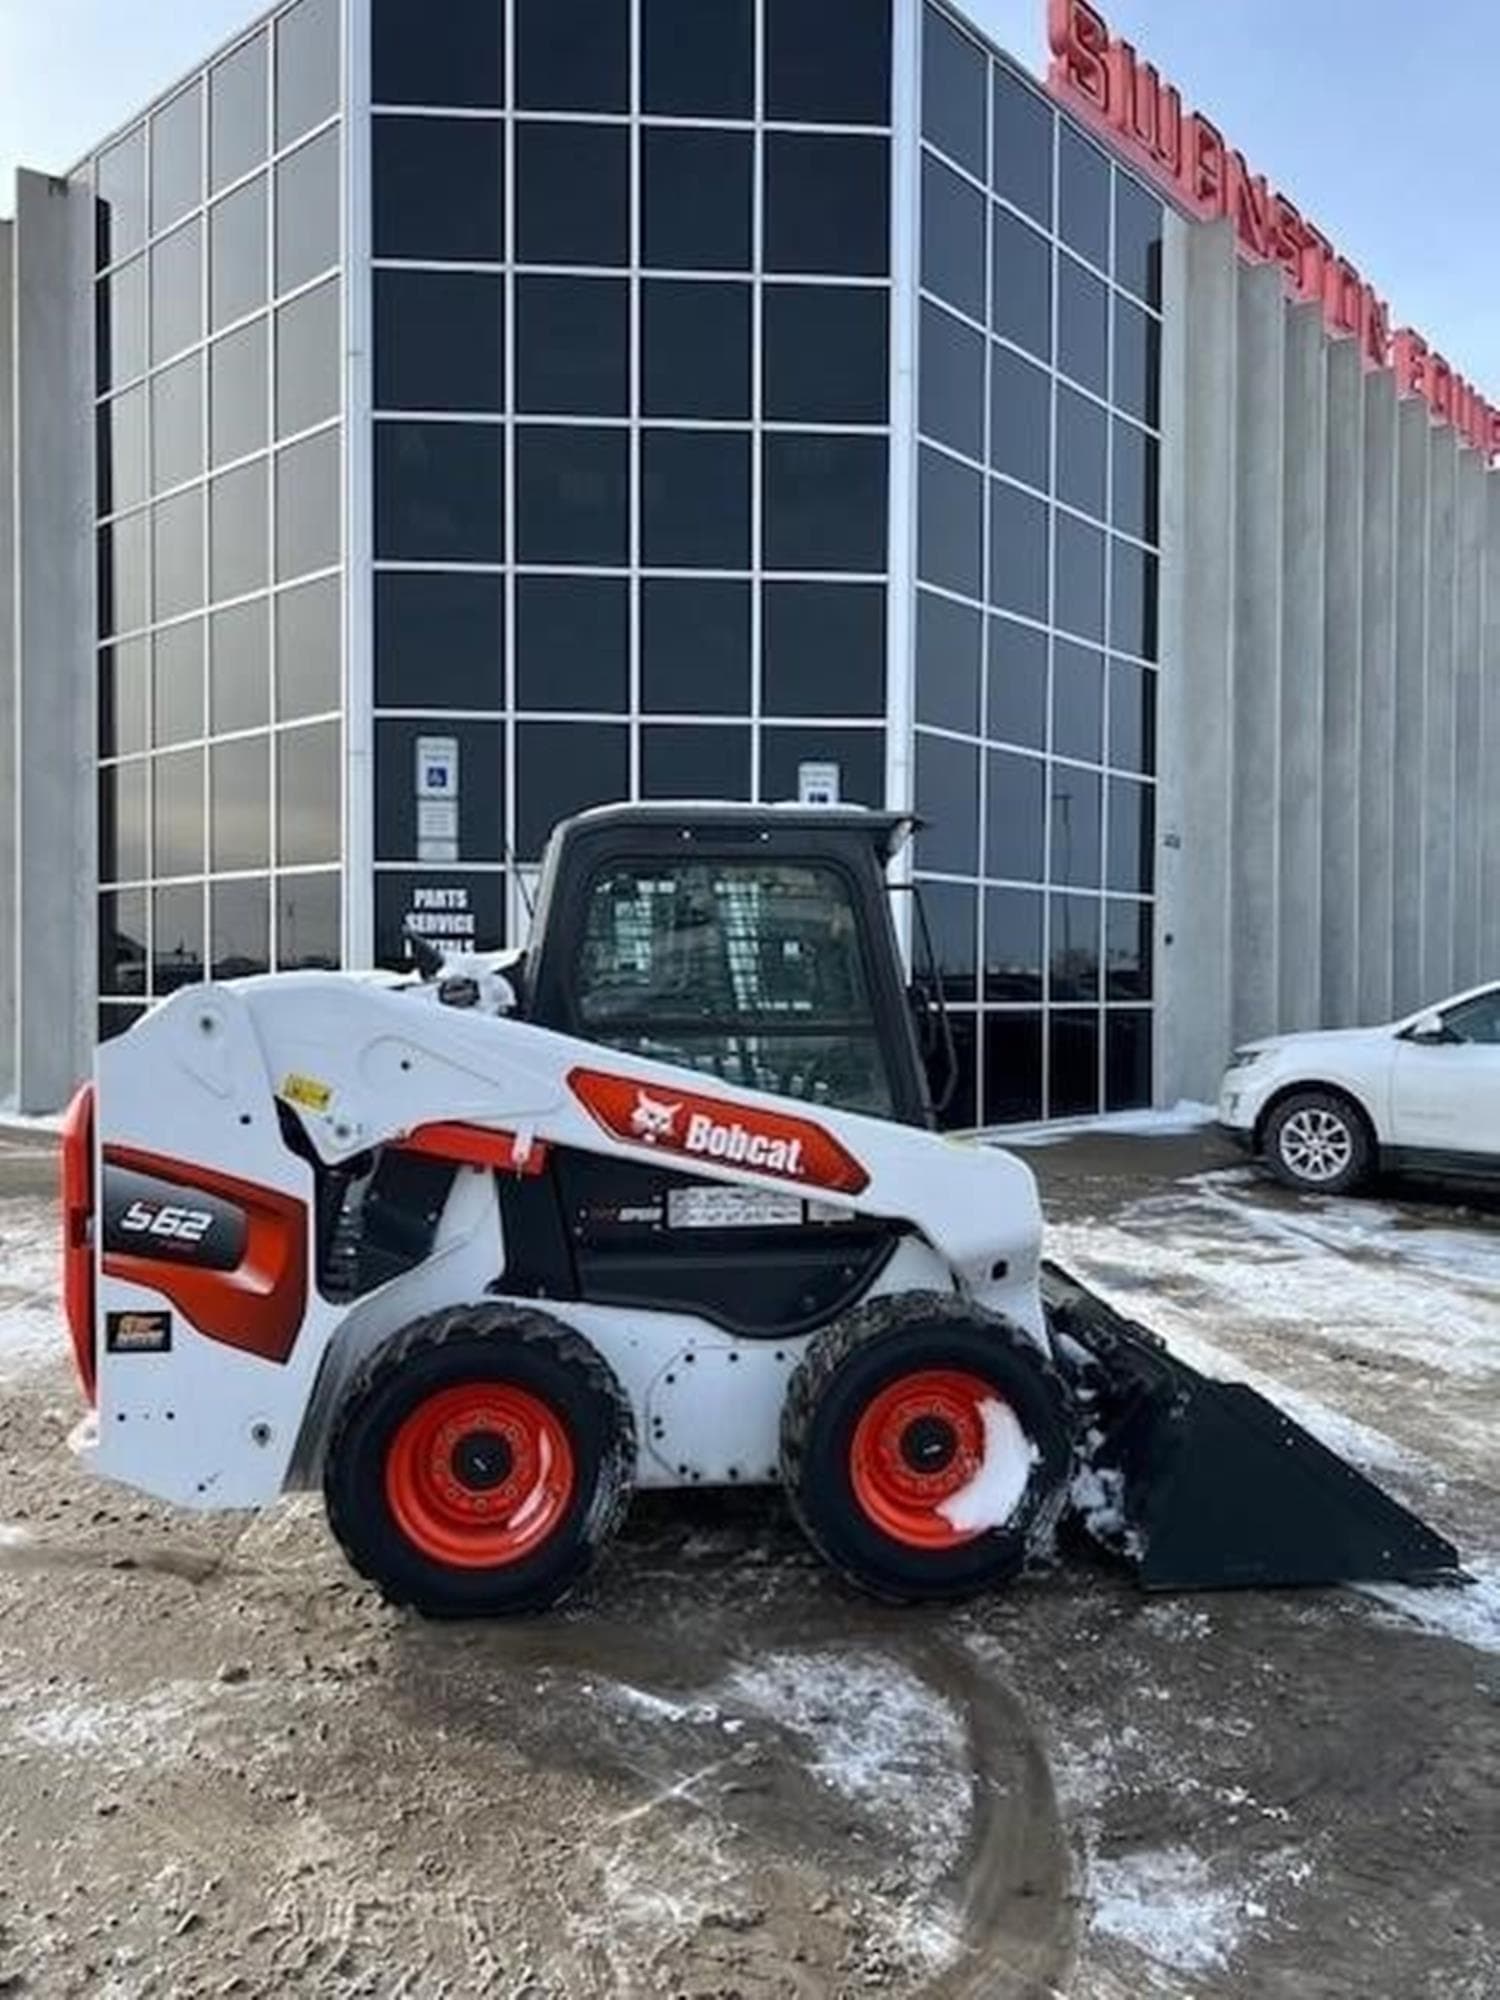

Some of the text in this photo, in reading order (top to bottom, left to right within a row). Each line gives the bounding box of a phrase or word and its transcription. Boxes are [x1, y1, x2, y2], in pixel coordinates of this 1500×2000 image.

[413, 889, 467, 909] PARTS
[405, 913, 475, 934] SERVICE
[685, 1113, 804, 1174] Bobcat
[119, 1201, 213, 1241] S62
